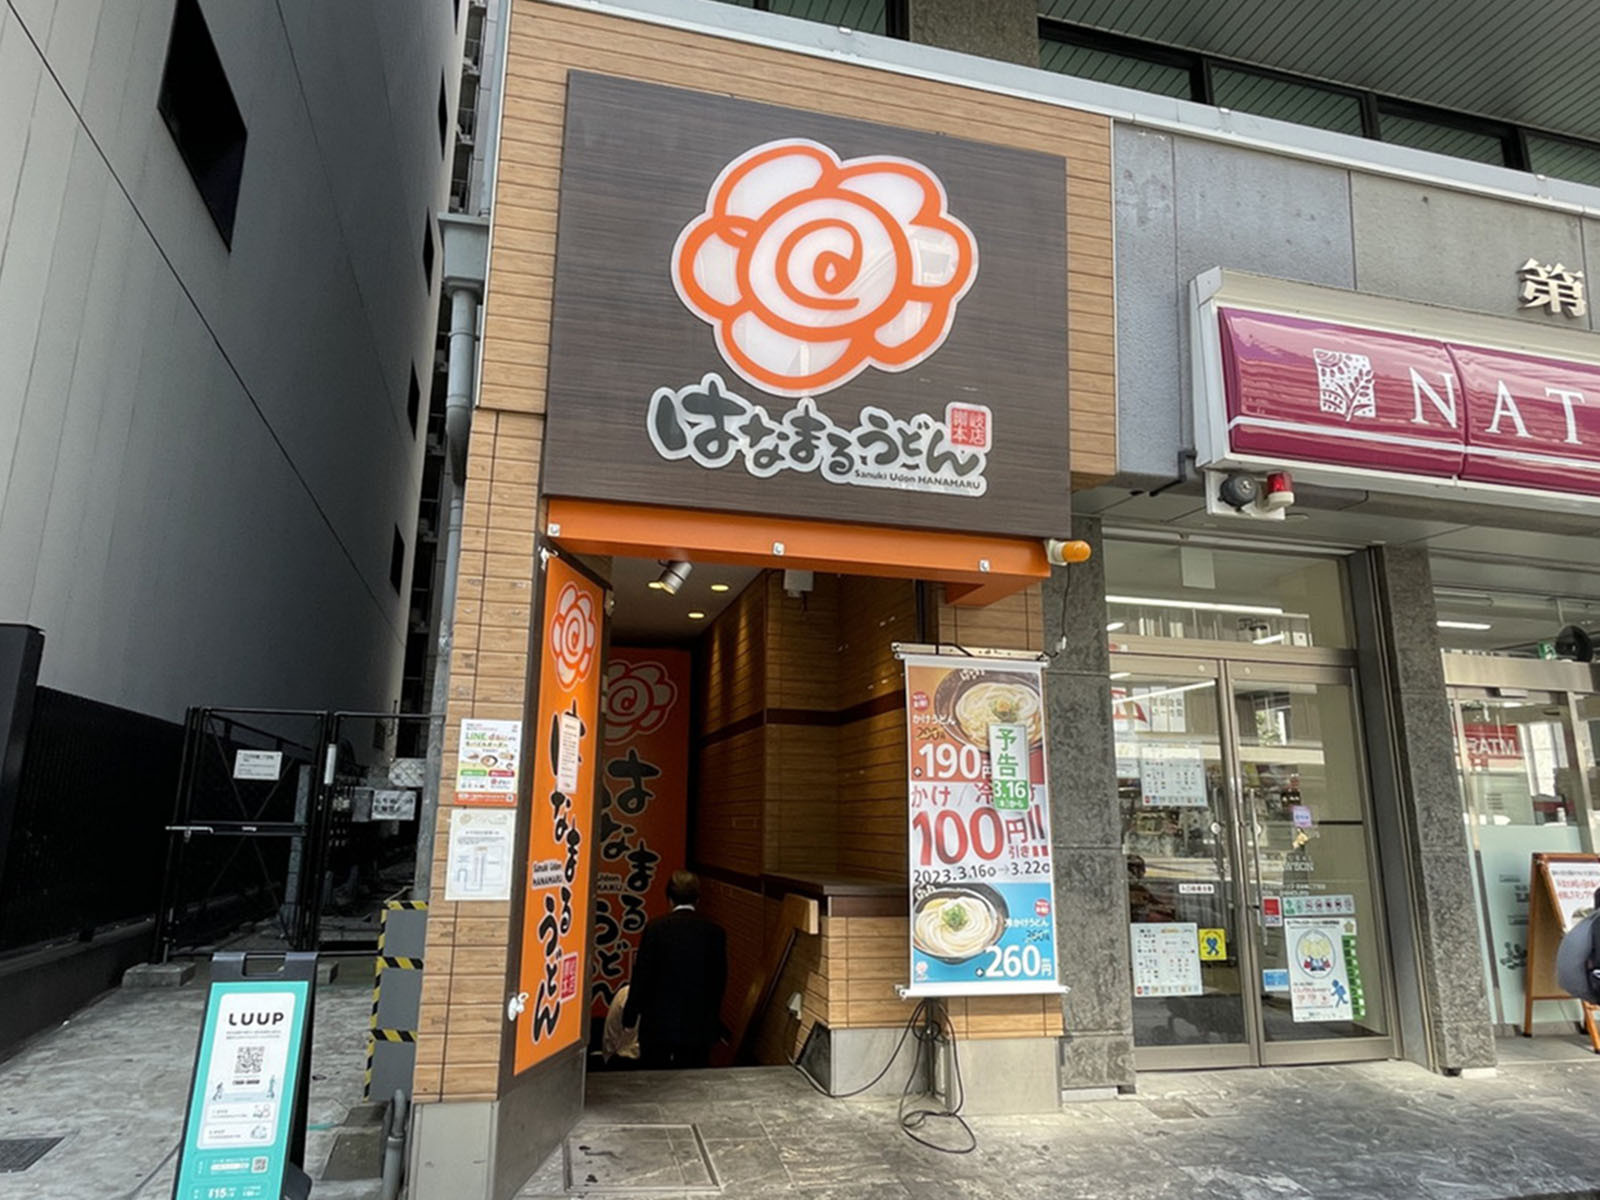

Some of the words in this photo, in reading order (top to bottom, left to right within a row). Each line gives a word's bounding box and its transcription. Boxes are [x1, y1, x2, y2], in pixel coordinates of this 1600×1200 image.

[1522, 258, 1587, 318] 第
[653, 379, 982, 477] はなまるうどん
[1408, 367, 1585, 445] NAT
[854, 470, 887, 480] Sanuki
[889, 472, 916, 482] Udon
[917, 476, 981, 490] HANAMARU
[996, 727, 1019, 777] 予告
[994, 781, 1027, 798] 3.16
[228, 1011, 285, 1026] LUUP
